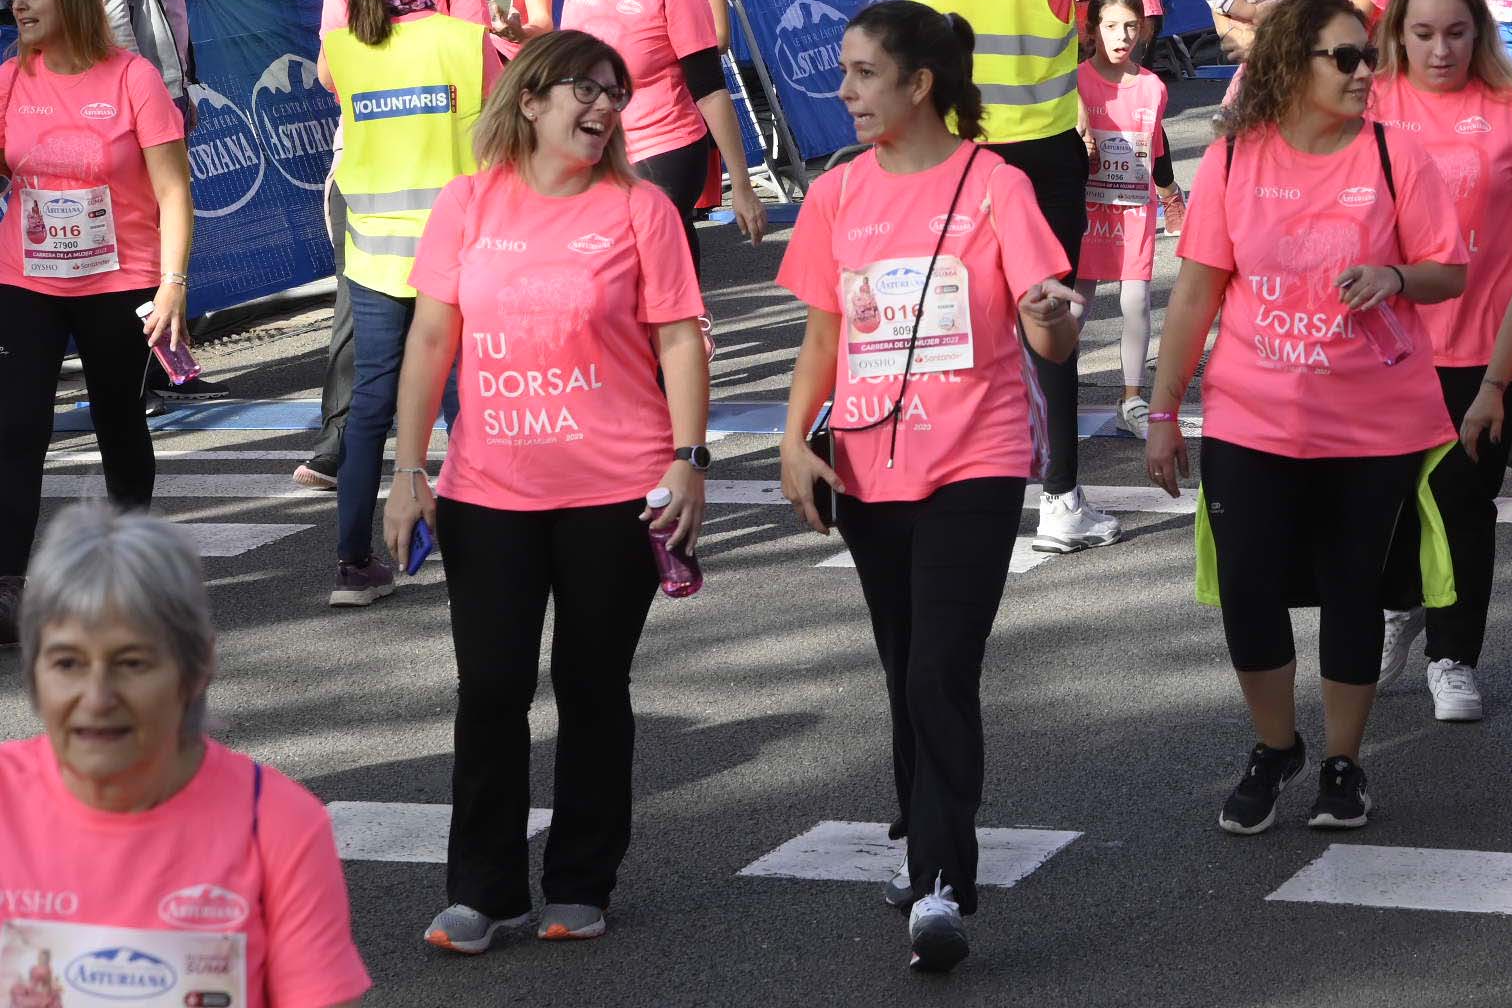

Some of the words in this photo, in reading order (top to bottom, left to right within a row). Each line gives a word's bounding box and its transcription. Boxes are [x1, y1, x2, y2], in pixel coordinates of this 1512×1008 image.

[354, 93, 447, 115] VOLUNTARIS
[1102, 160, 1129, 171] 016
[48, 224, 81, 238] 016
[848, 221, 890, 241] OYSHO
[53, 241, 78, 249] 27900
[31, 263, 58, 272] OYSHO
[1249, 275, 1281, 302] TU
[883, 303, 925, 322] 016
[893, 325, 918, 337] 809
[473, 332, 507, 360] TU
[861, 342, 893, 352] CARRERA
[894, 341, 904, 349] DE
[915, 338, 940, 347] MUJER
[1254, 335, 1331, 368] SUMA
[859, 357, 896, 370] OYSHO
[479, 363, 603, 398] DORSAL
[845, 393, 928, 423] SUMA
[483, 406, 579, 436] SUMA
[0, 890, 78, 916] YSHO
[167, 897, 241, 920] ASTURIANA
[75, 965, 168, 990] ASTURIANA
